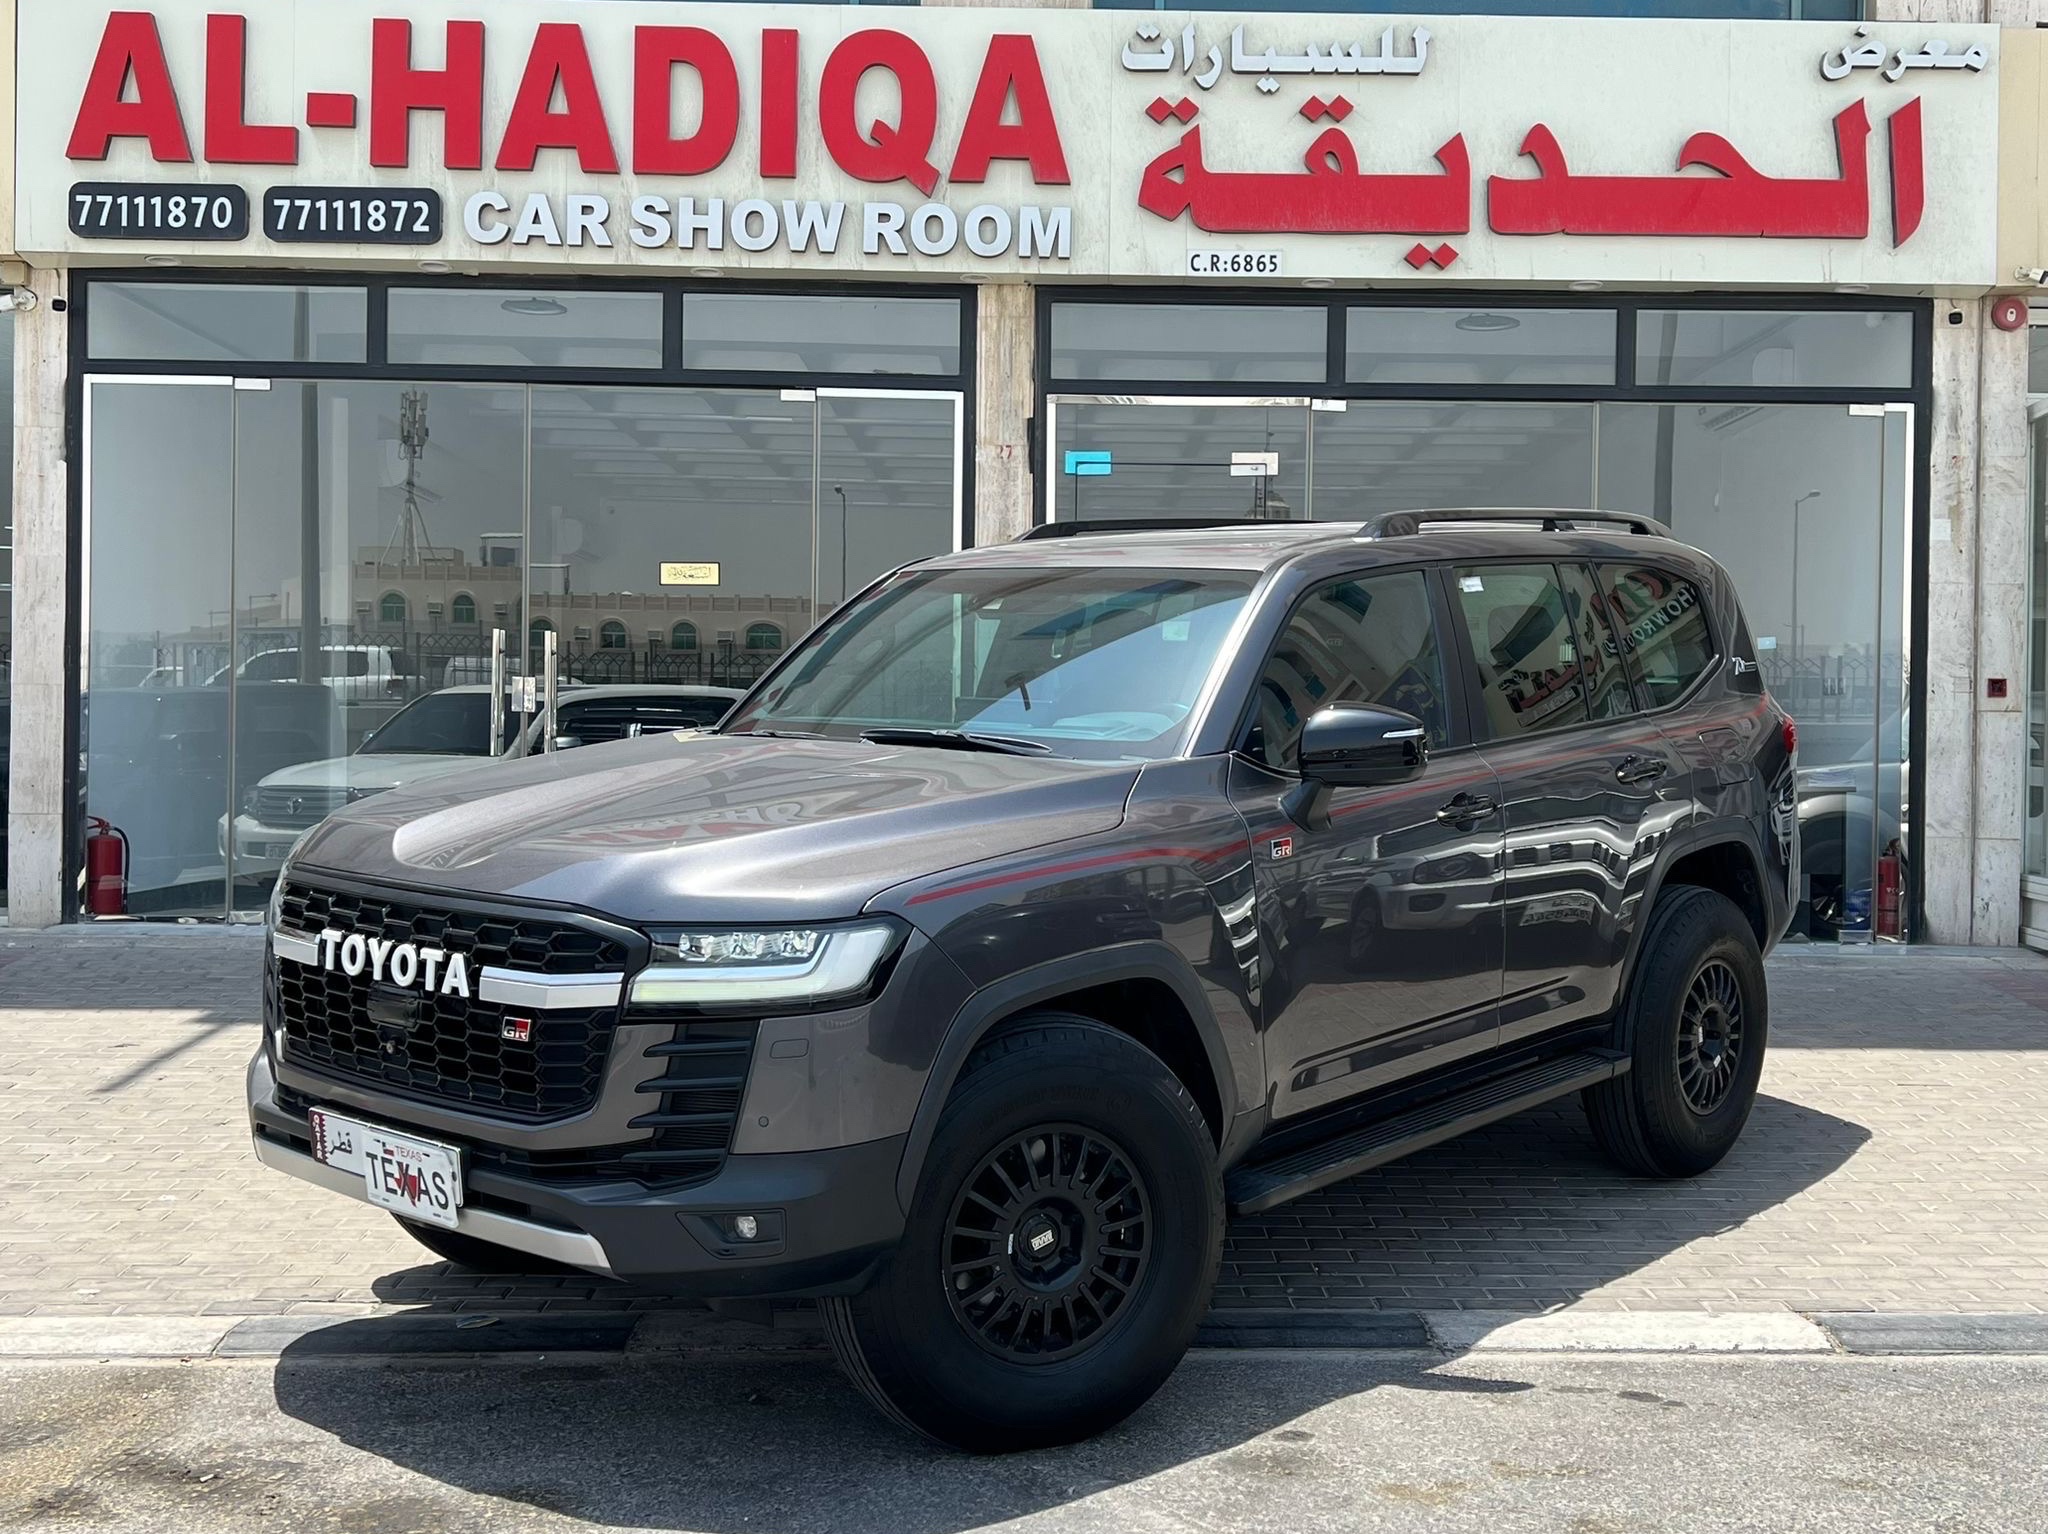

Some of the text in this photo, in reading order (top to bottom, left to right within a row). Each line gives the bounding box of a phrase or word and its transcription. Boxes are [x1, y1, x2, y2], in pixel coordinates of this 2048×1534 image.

[1121, 22, 1432, 93] للسيارات
[1820, 26, 1989, 83] معرض
[65, 10, 1071, 198] AL-HADIQA
[1137, 95, 1925, 271] الحديقة
[75, 194, 233, 230] 77111870
[273, 199, 430, 233] 77111872
[463, 191, 1071, 259] CAR SHOW ROOM
[1190, 253, 1279, 273] C.R:6865
[1274, 845, 1290, 857] GR
[321, 927, 470, 998] TOYOTA
[503, 1025, 527, 1039] GR
[312, 1114, 323, 1159] QATAR
[329, 1130, 353, 1155] قطر
[395, 1146, 423, 1163] TEXAS
[366, 1151, 449, 1210] TEXAS
